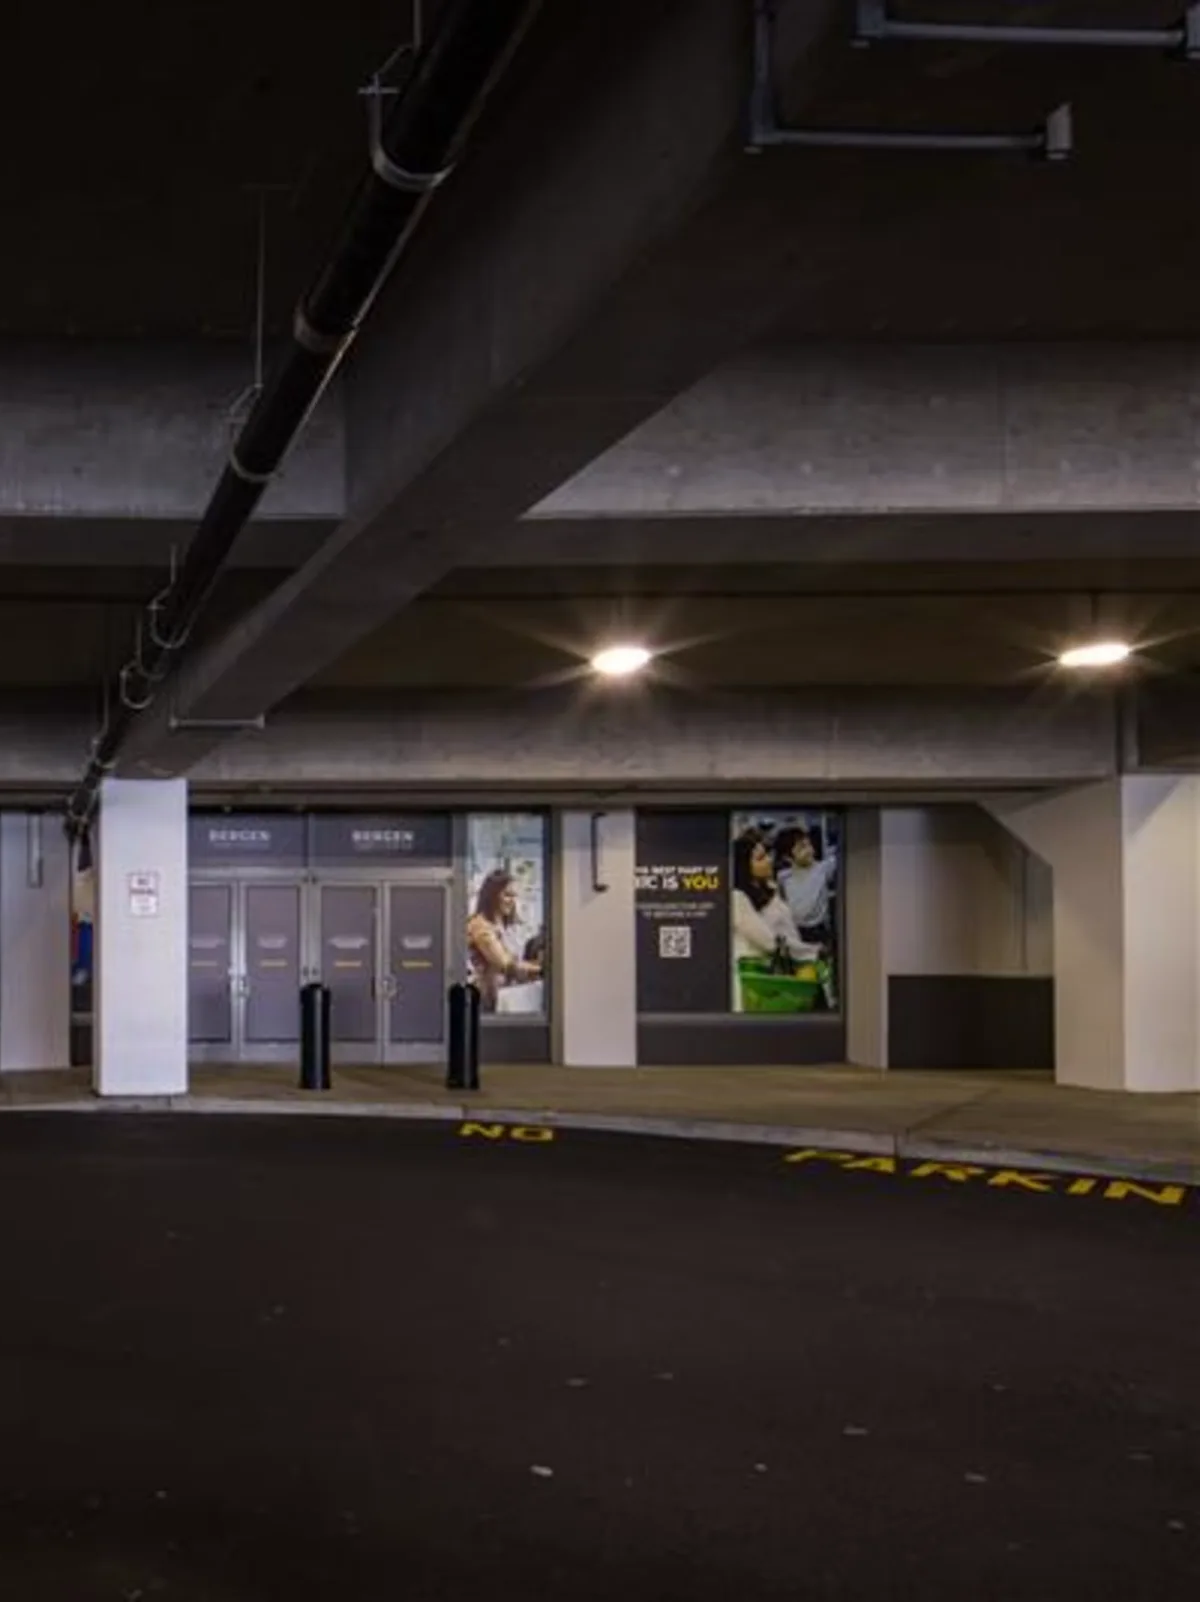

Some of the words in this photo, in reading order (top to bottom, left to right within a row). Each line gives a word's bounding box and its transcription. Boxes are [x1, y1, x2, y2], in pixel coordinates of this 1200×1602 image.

[662, 876, 679, 891] IS
[682, 876, 720, 891] YOU
[459, 1123, 553, 1141] NO
[784, 1150, 1184, 1204] PARKIN
